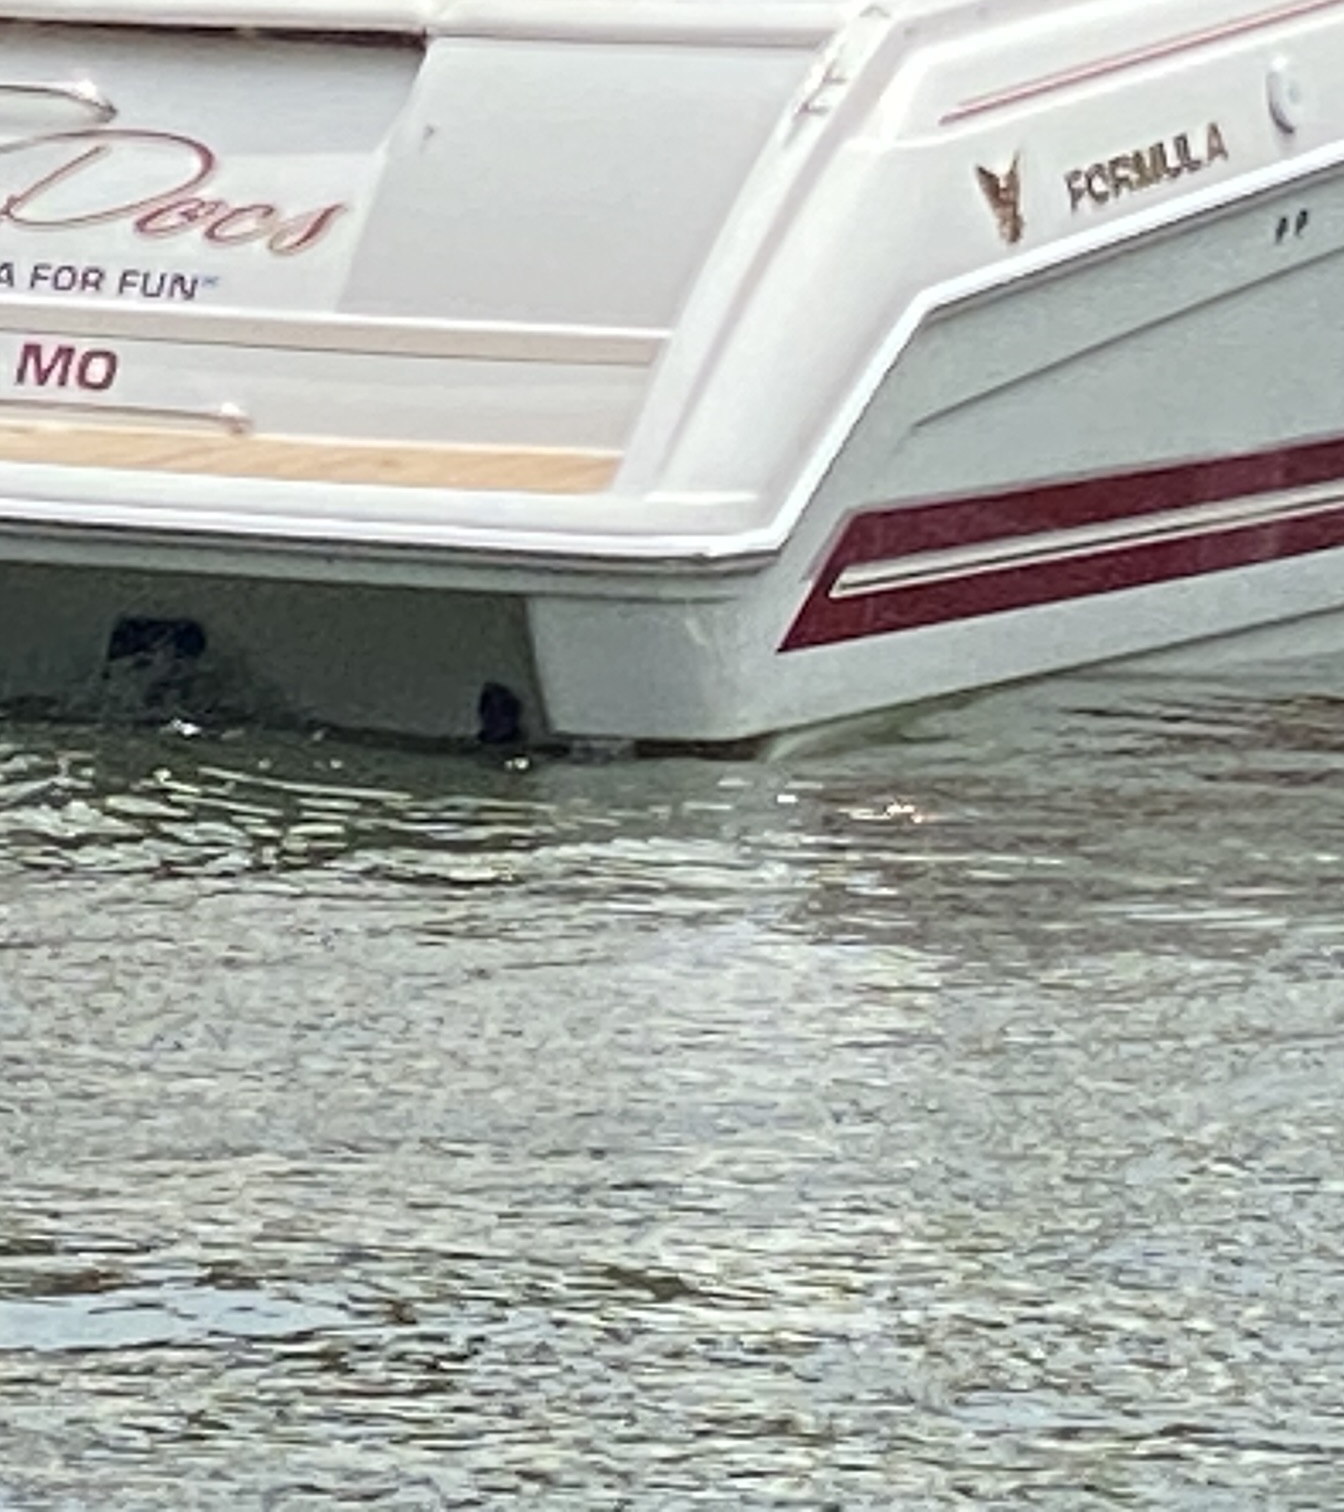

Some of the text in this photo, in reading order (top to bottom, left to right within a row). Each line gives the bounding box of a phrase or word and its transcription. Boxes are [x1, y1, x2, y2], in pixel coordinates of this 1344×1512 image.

[1064, 121, 1229, 213] FORMULA
[28, 263, 105, 295] FOR
[15, 343, 119, 392] MO
